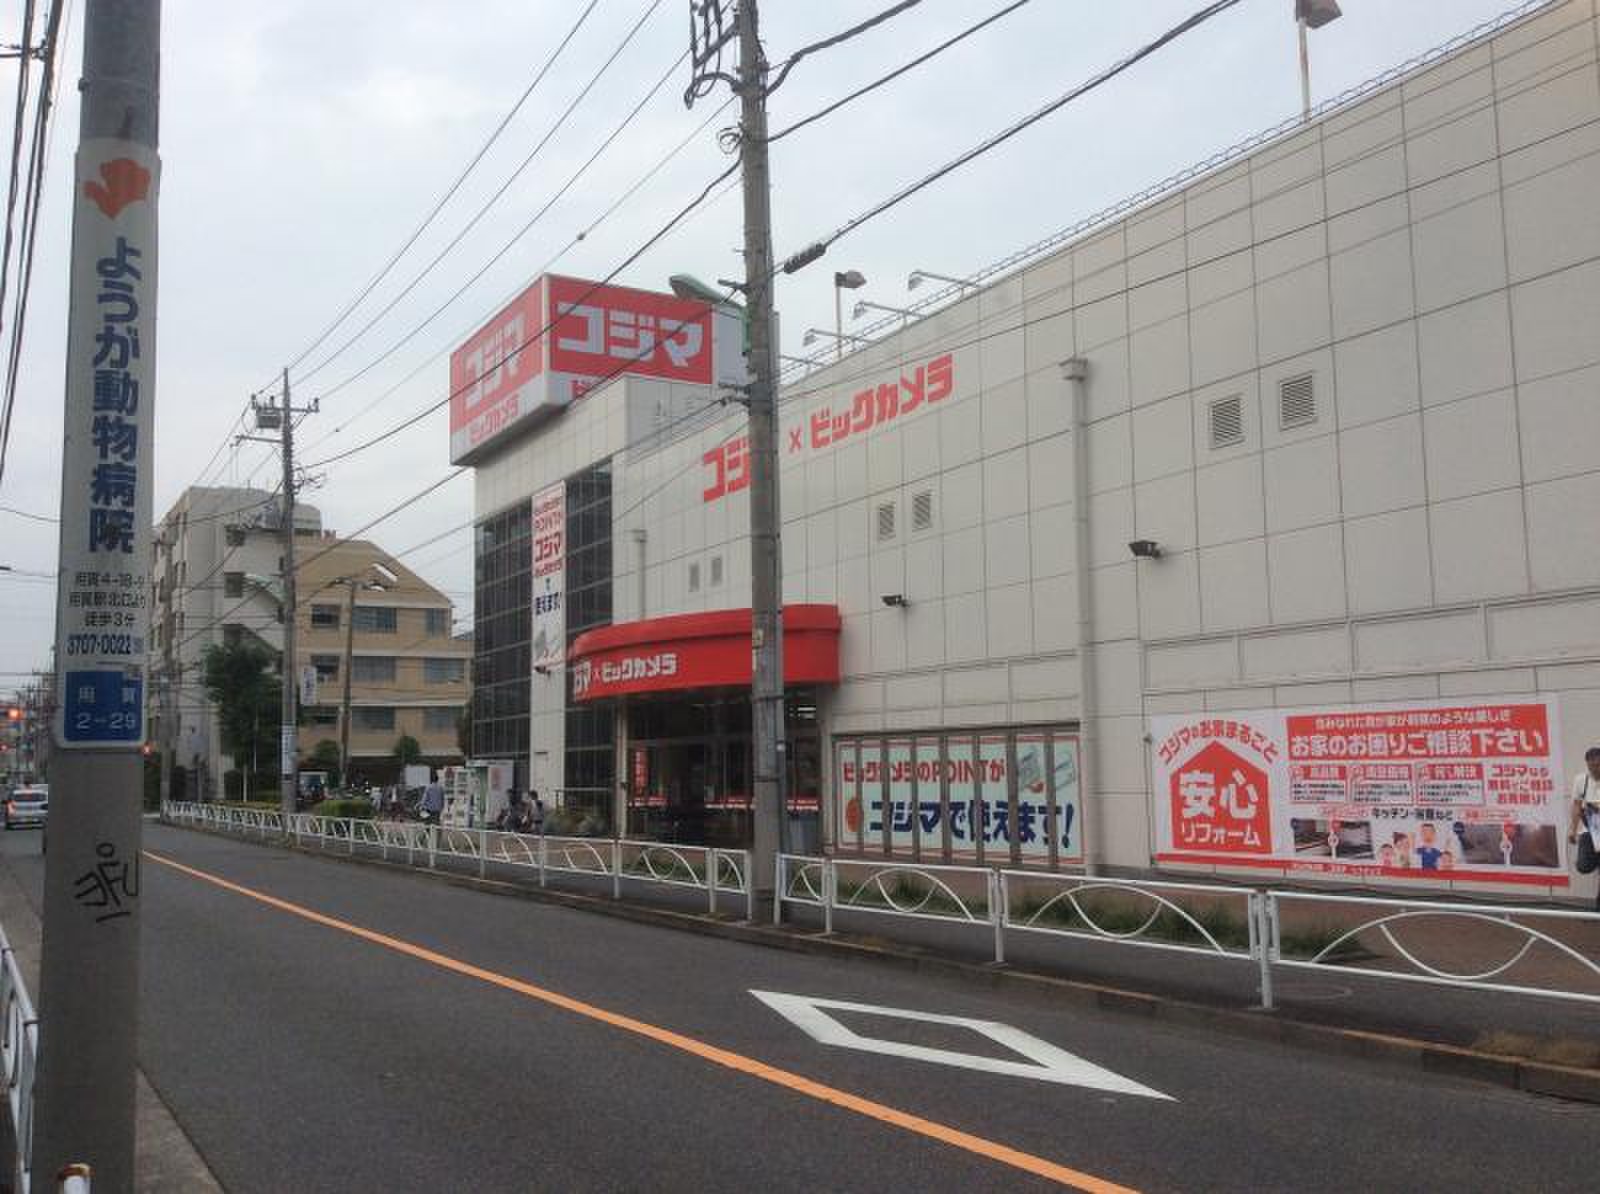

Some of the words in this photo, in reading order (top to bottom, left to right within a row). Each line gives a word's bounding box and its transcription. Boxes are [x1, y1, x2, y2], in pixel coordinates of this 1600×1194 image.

[556, 302, 705, 367] コジマ
[465, 311, 526, 409] コジマ
[90, 236, 143, 553] ようが動物病院
[703, 434, 751, 503] コジ
[811, 354, 953, 449] ビックカメラ
[535, 532, 562, 563] コジマ
[84, 611, 136, 628] 徒歩3分
[602, 653, 678, 683] ビックカメラ
[1291, 728, 1544, 757] お家のお困りご相談下さい
[1179, 768, 1259, 821] 安心
[1182, 821, 1262, 847] リフォーム
